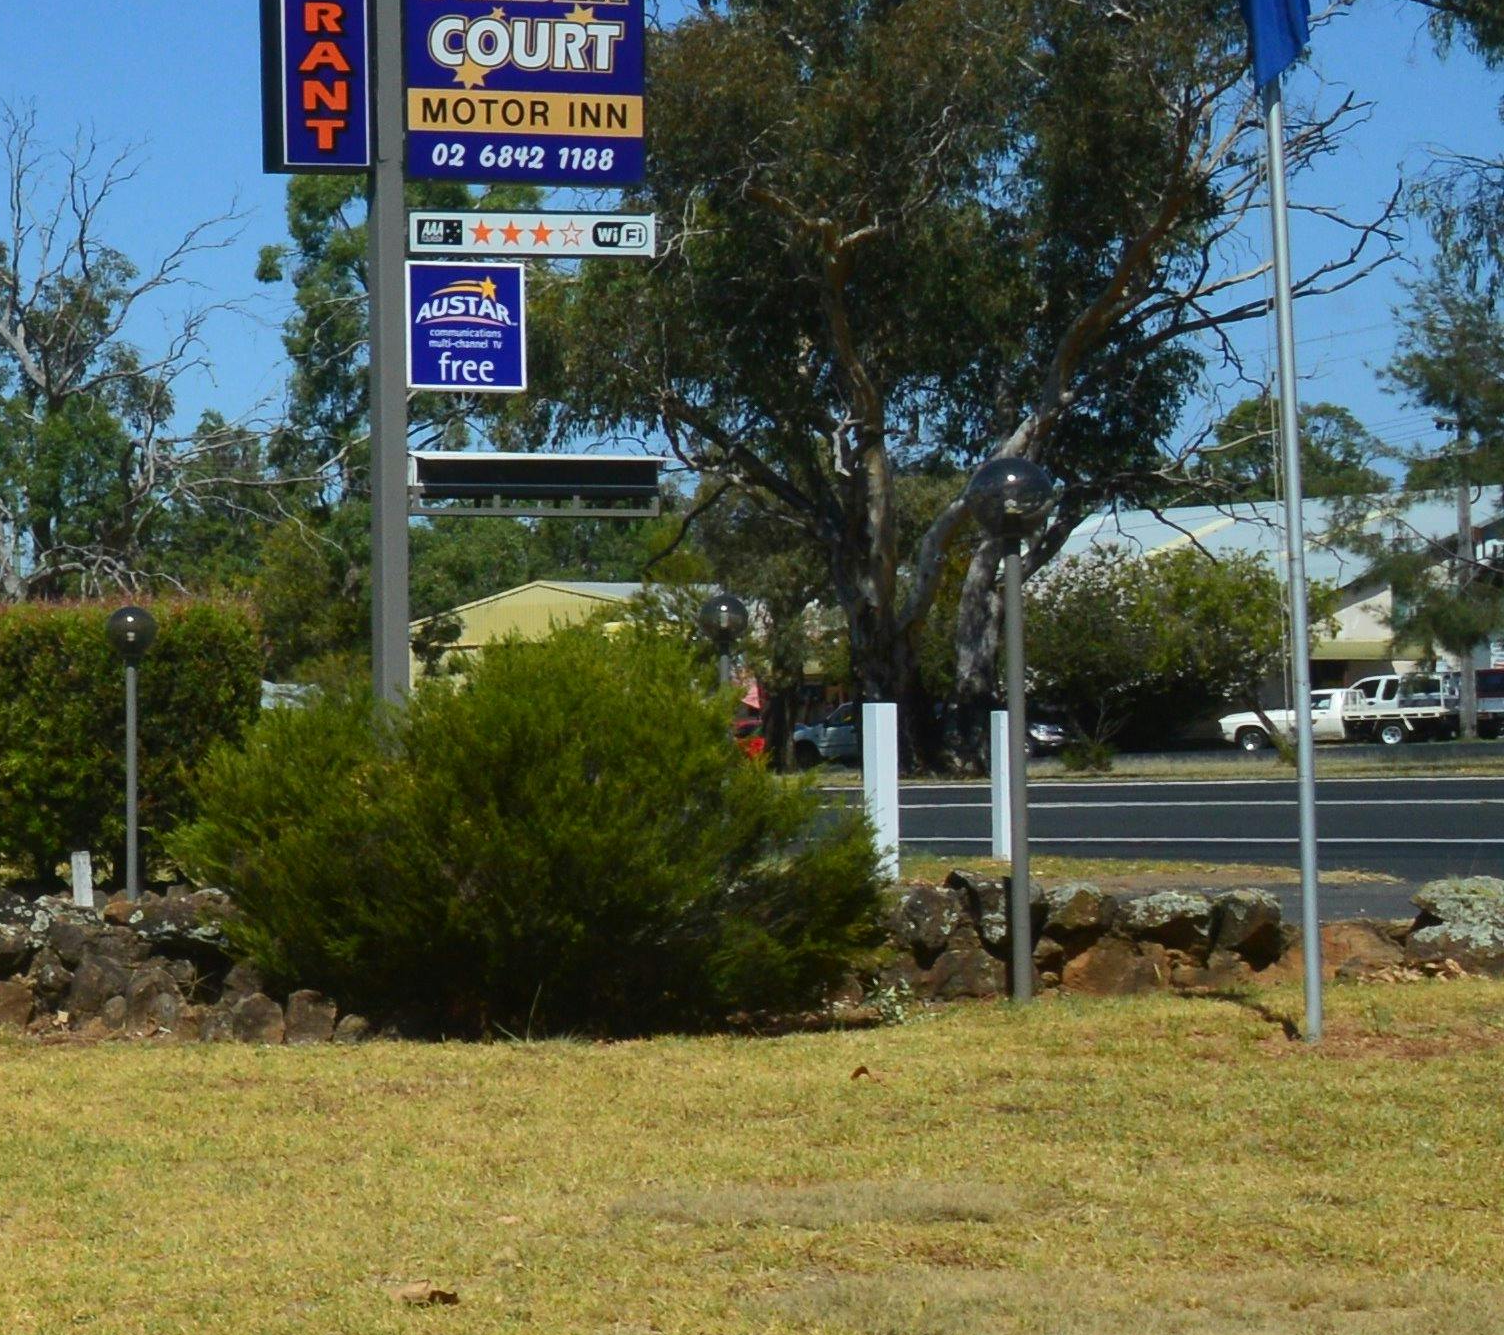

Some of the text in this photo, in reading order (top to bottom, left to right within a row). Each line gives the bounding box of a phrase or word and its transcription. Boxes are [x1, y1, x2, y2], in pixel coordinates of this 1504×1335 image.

[429, 15, 624, 73] COURT
[421, 97, 627, 129] MOTOR INN
[431, 142, 614, 172] 02 6842 1188
[422, 221, 444, 235] AAA
[415, 295, 512, 326] AUSTAR
[428, 338, 503, 349] multi-channel TV
[429, 328, 502, 338] communications
[437, 351, 495, 383] free
